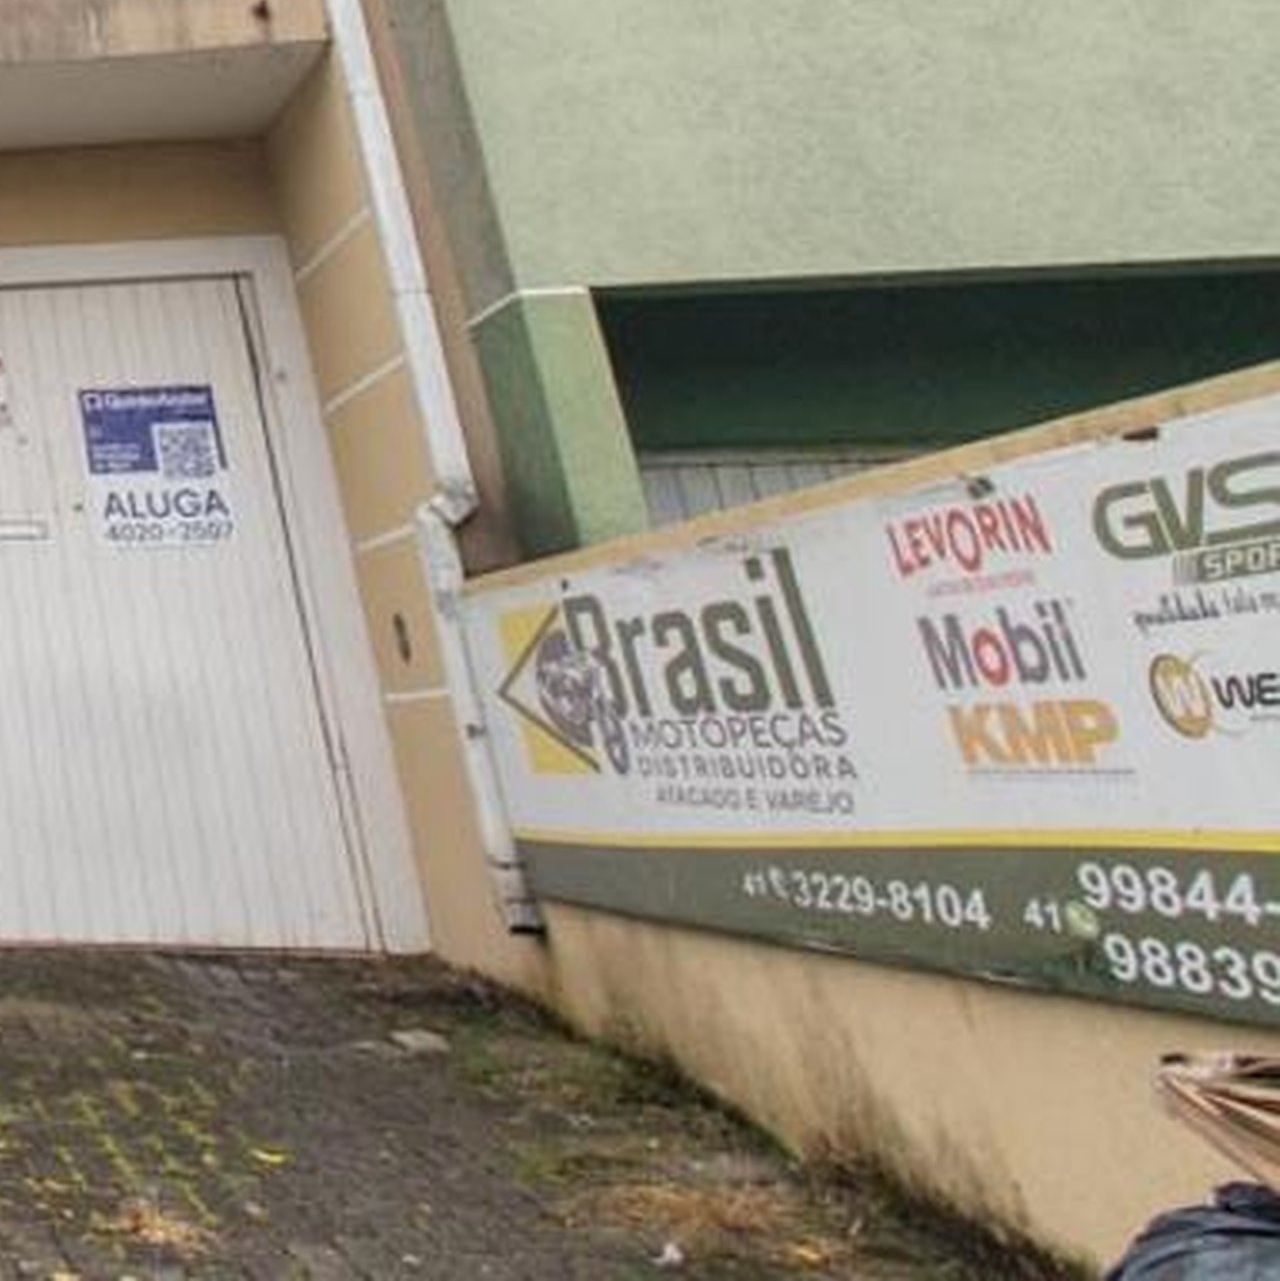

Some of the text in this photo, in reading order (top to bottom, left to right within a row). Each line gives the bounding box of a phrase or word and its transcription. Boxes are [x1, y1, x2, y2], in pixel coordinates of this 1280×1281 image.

[104, 488, 230, 520] ALUGA
[886, 493, 1053, 576] LEVORIN
[1092, 451, 1280, 561] GVS
[561, 546, 836, 718] Brasil
[916, 599, 1088, 692] Mobil
[630, 711, 847, 753] MOTOPEÇAS
[946, 700, 1120, 764] KMP
[638, 754, 859, 780] DISTRIBUIDORA
[765, 788, 855, 816] VAREJO
[791, 870, 991, 931] 3229-8104
[1023, 897, 1062, 934] 41
[1103, 933, 1280, 1005] 98839
